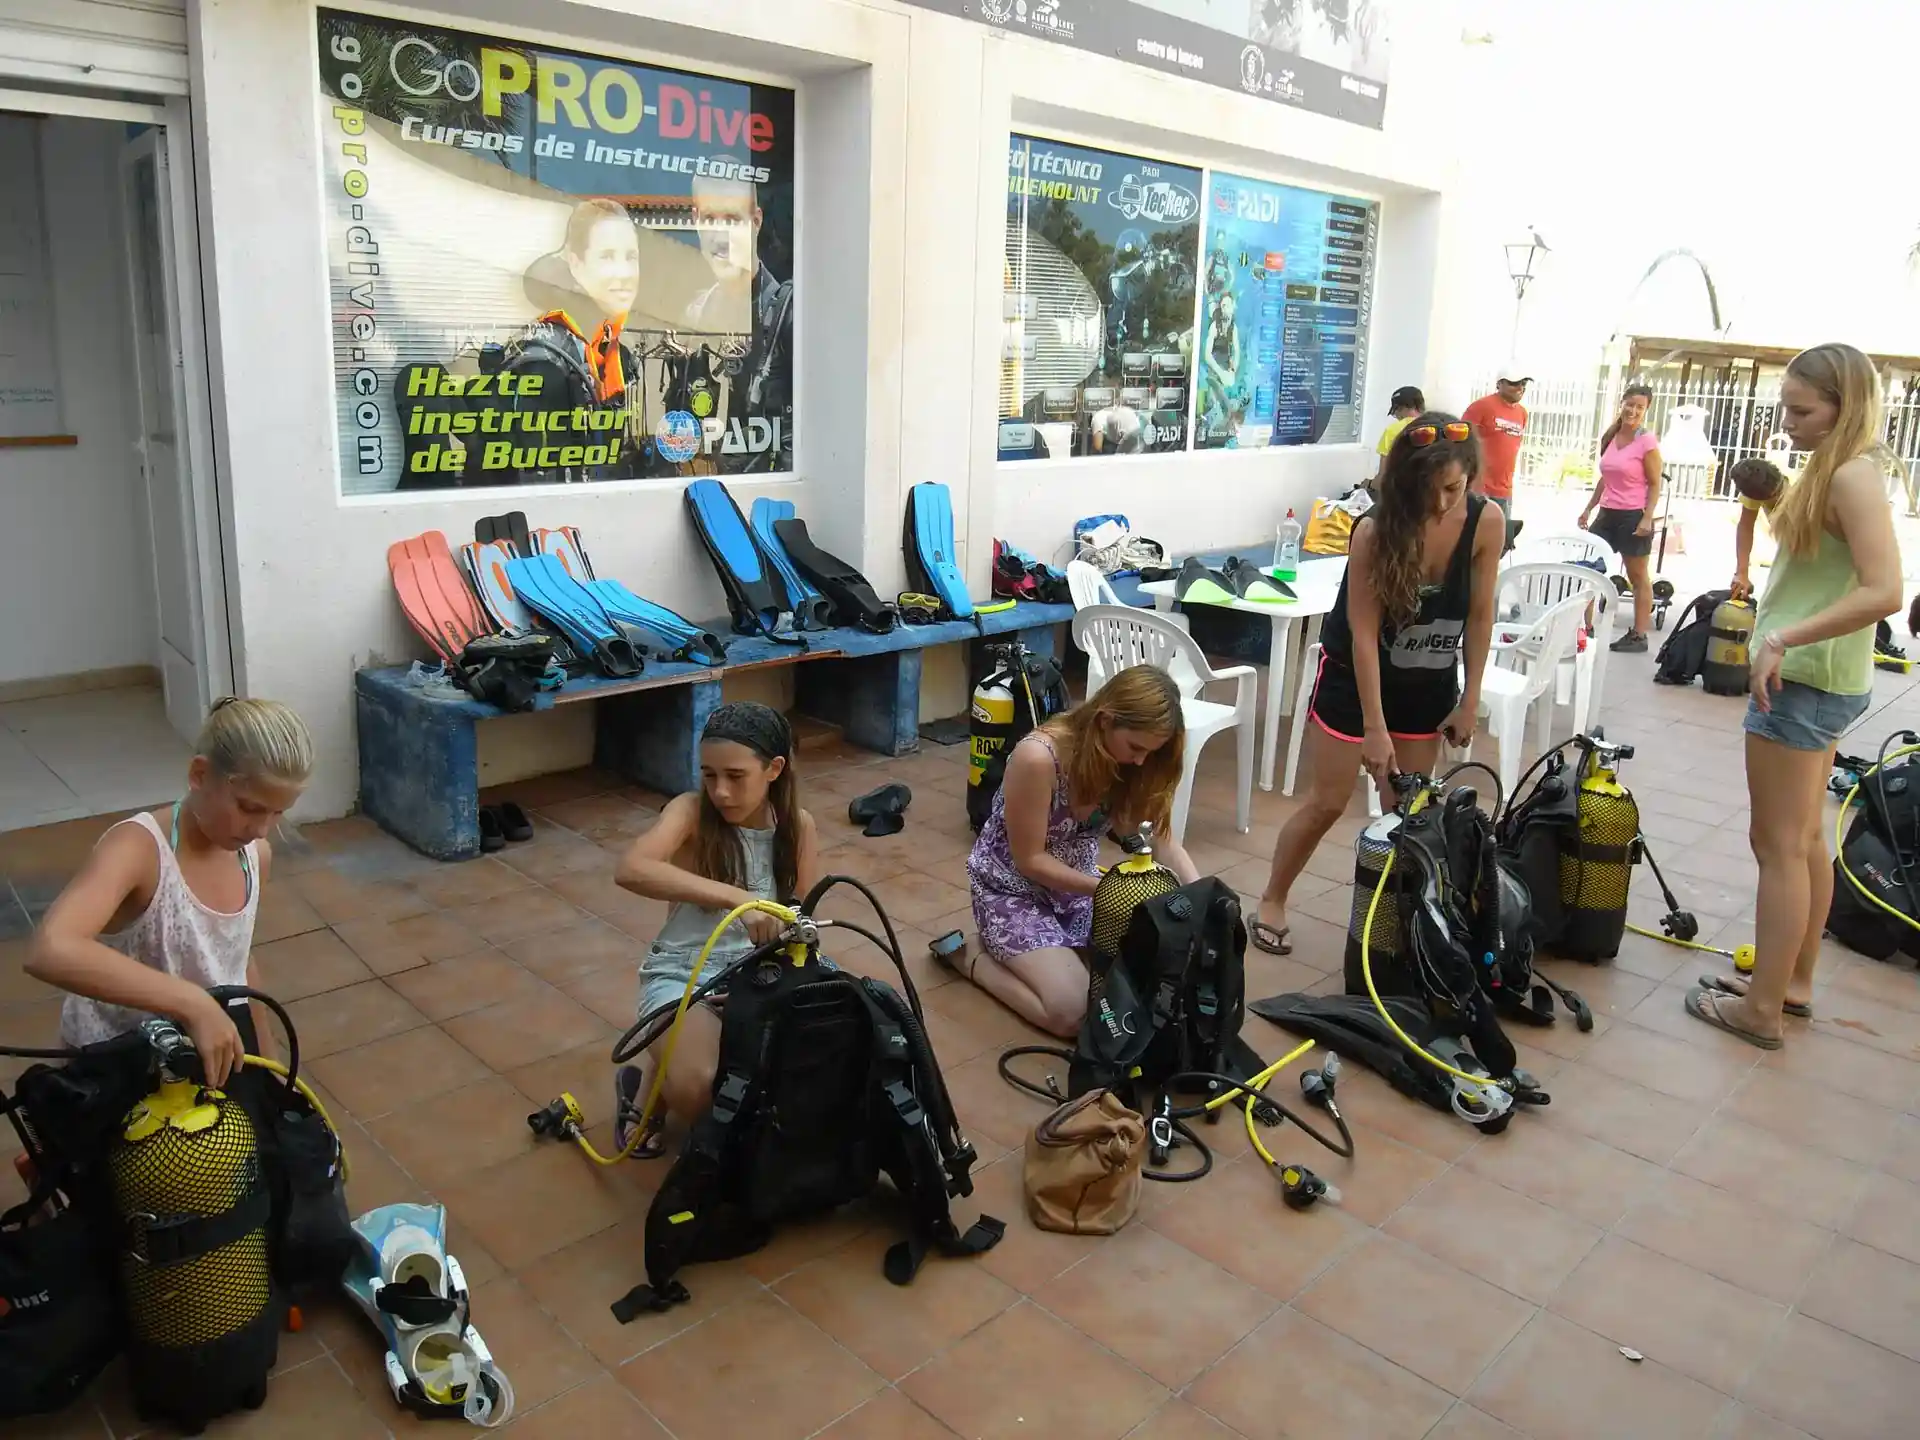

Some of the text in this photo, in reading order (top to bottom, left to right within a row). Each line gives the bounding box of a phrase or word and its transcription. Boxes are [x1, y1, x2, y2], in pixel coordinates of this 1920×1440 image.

[400, 116, 771, 184] Cursos de Instructores
[1031, 151, 1103, 181] TÉCNICO
[1141, 165, 1160, 178] PADI
[1008, 175, 1102, 205] IDEMOUNT
[1144, 187, 1190, 218] TecRec
[1237, 189, 1279, 224] PADI
[407, 367, 544, 397] Hazte
[409, 405, 629, 436] instructor
[702, 416, 782, 455] PADI
[1156, 427, 1183, 443] PADI
[410, 437, 620, 473] de Buceo!
